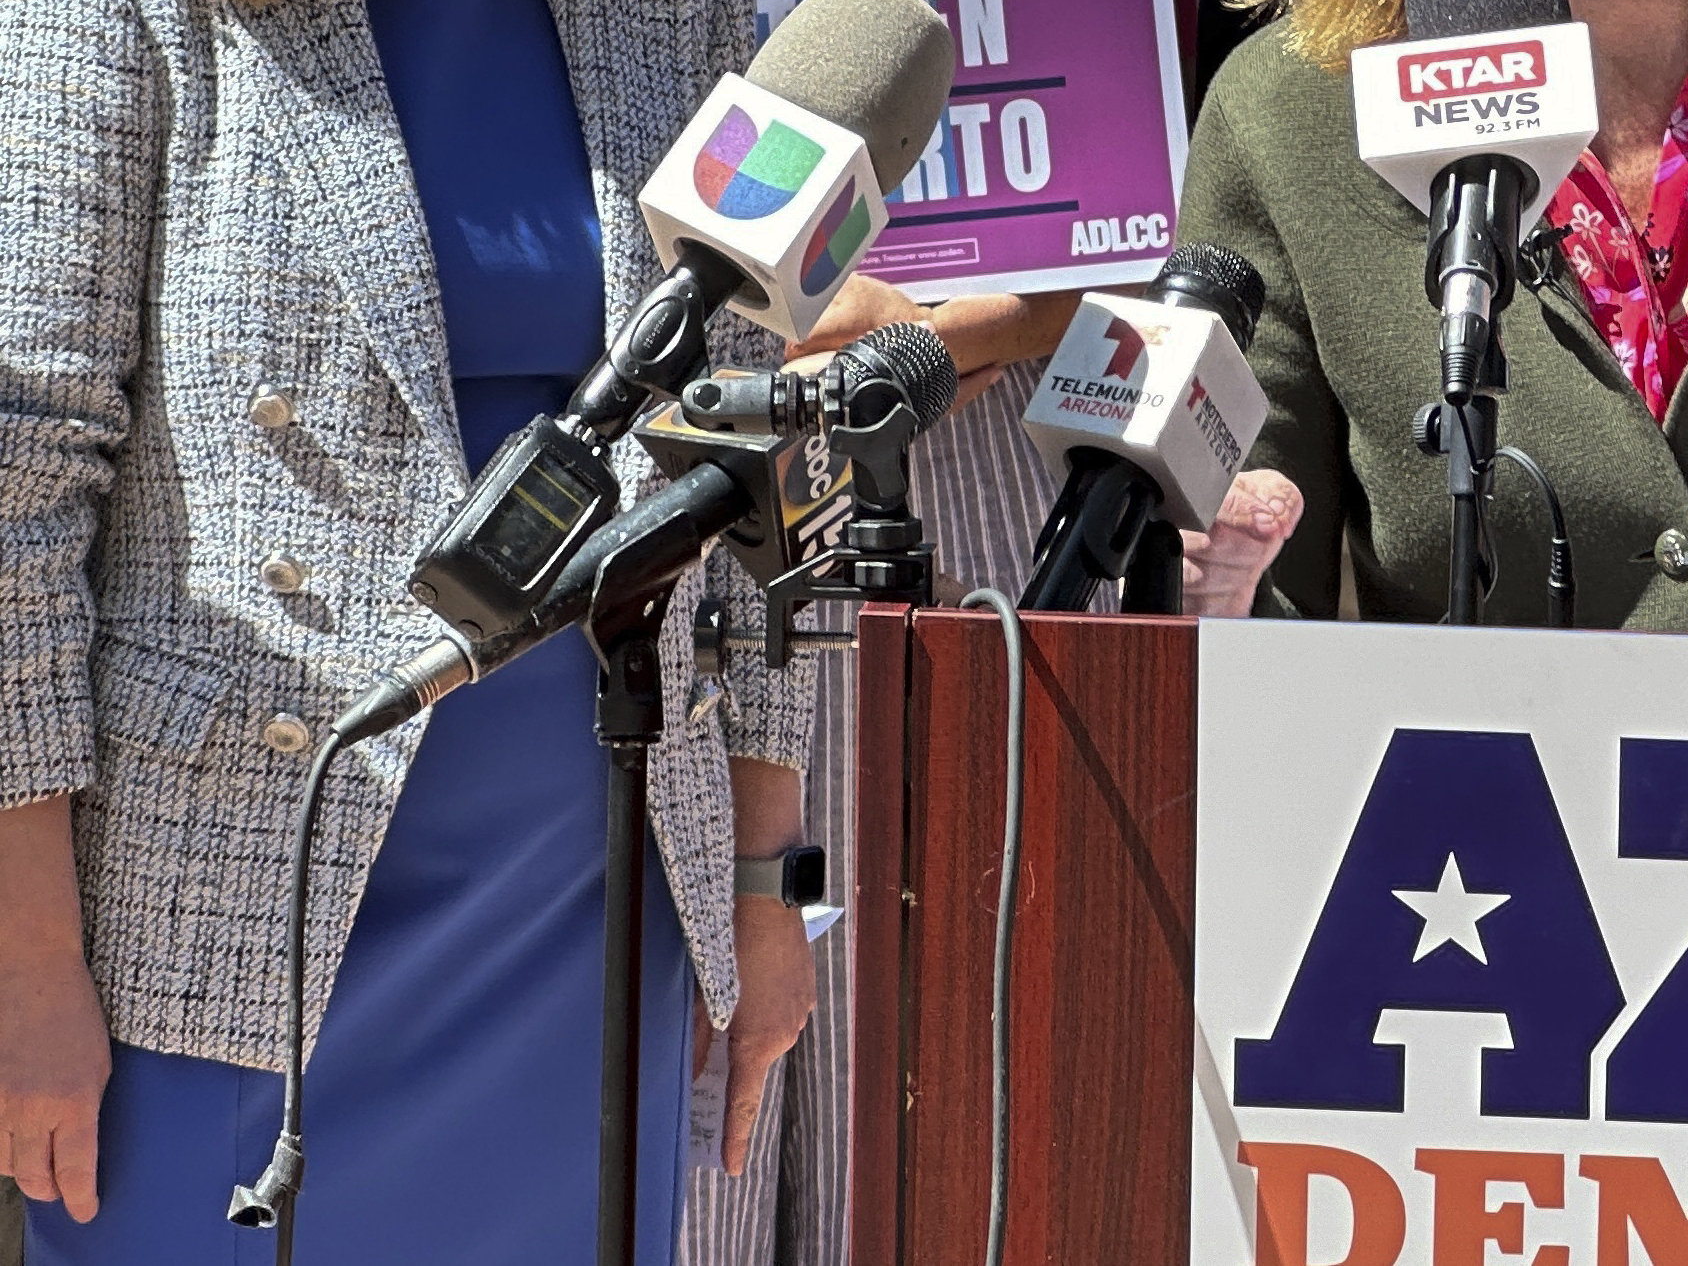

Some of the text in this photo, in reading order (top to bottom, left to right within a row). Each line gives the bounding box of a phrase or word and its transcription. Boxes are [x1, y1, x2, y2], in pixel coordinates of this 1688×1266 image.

[1409, 51, 1537, 94] KTAR
[1413, 92, 1540, 127] NEWS
[1475, 118, 1541, 135] 92.3 FM
[1070, 214, 1171, 257] ADLCC
[1194, 412, 1235, 476] ARIZONA
[1201, 395, 1242, 462] NOTICIERO
